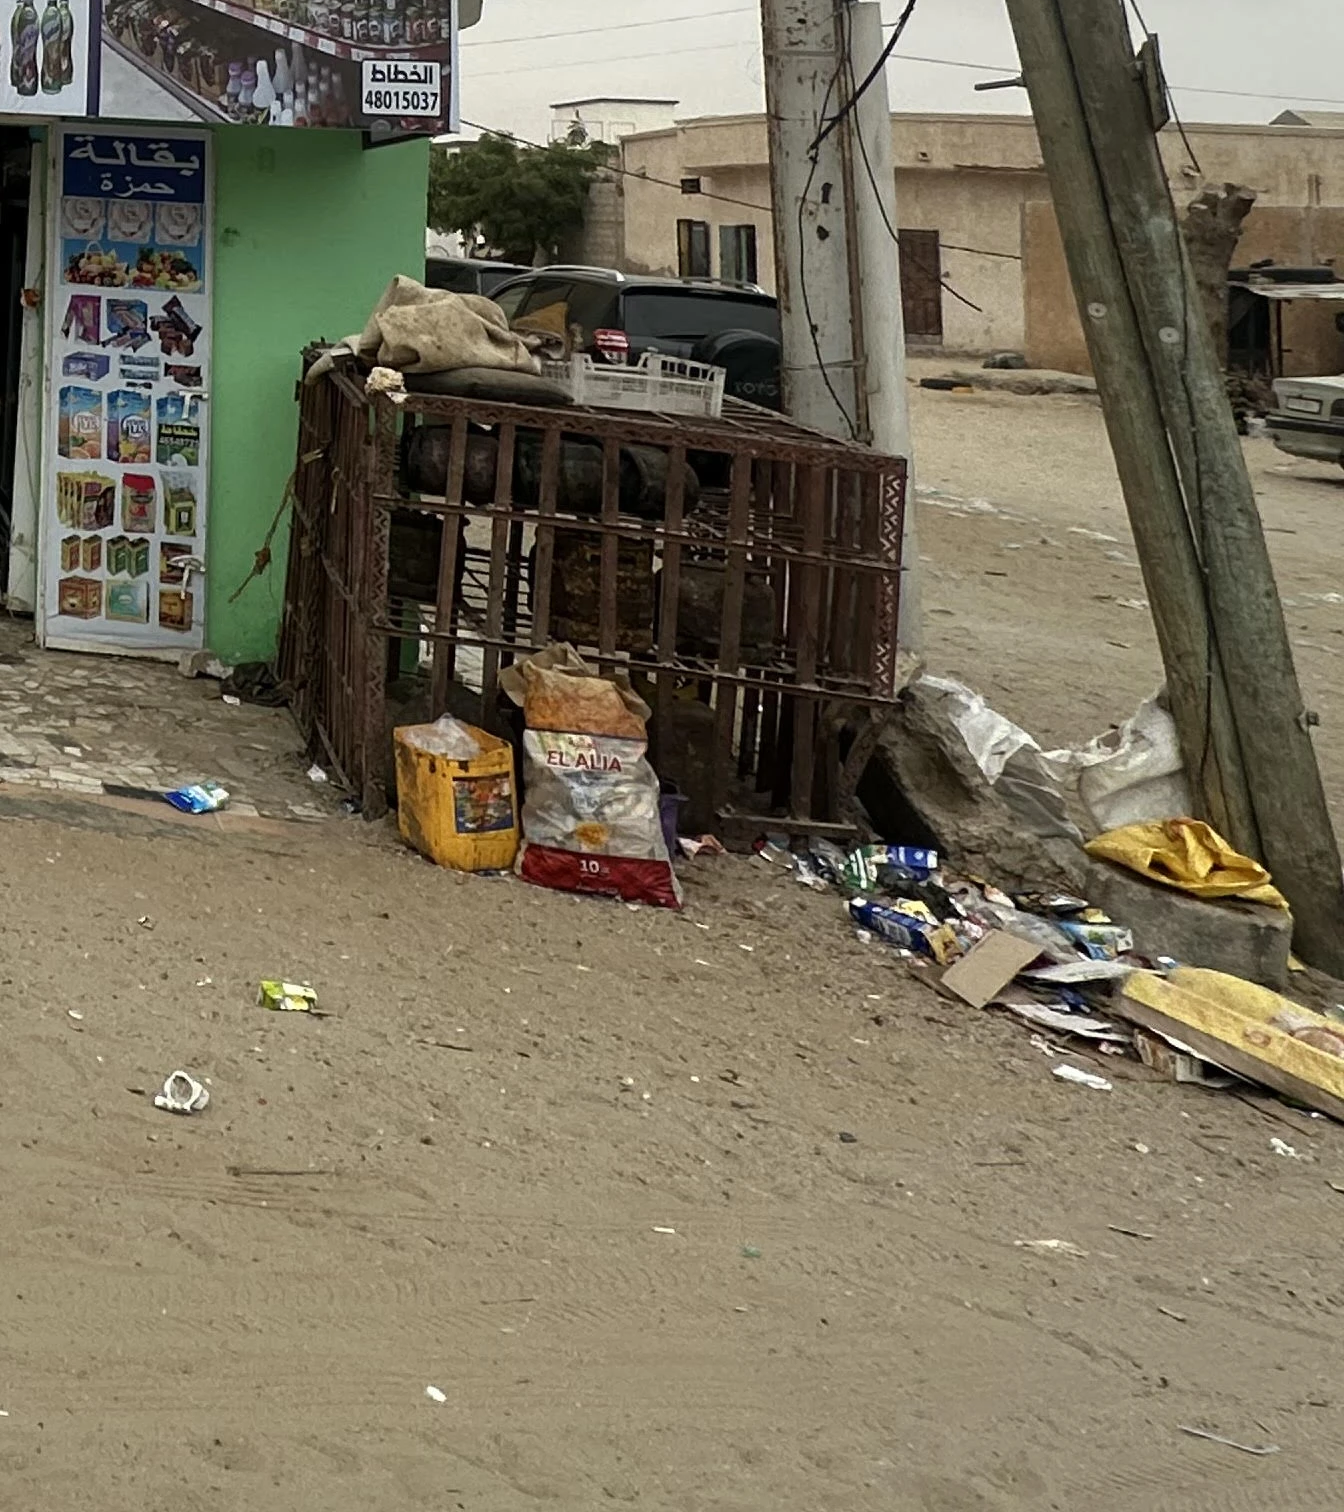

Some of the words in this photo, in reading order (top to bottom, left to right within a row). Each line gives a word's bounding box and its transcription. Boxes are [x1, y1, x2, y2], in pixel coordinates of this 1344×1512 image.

[370, 63, 433, 85] الخطاط
[364, 90, 439, 112] 48015037
[69, 135, 200, 176] بقالة
[100, 172, 176, 198] حمزة
[547, 750, 570, 768] EL
[575, 752, 622, 773] ALIA
[580, 859, 600, 874] 10
